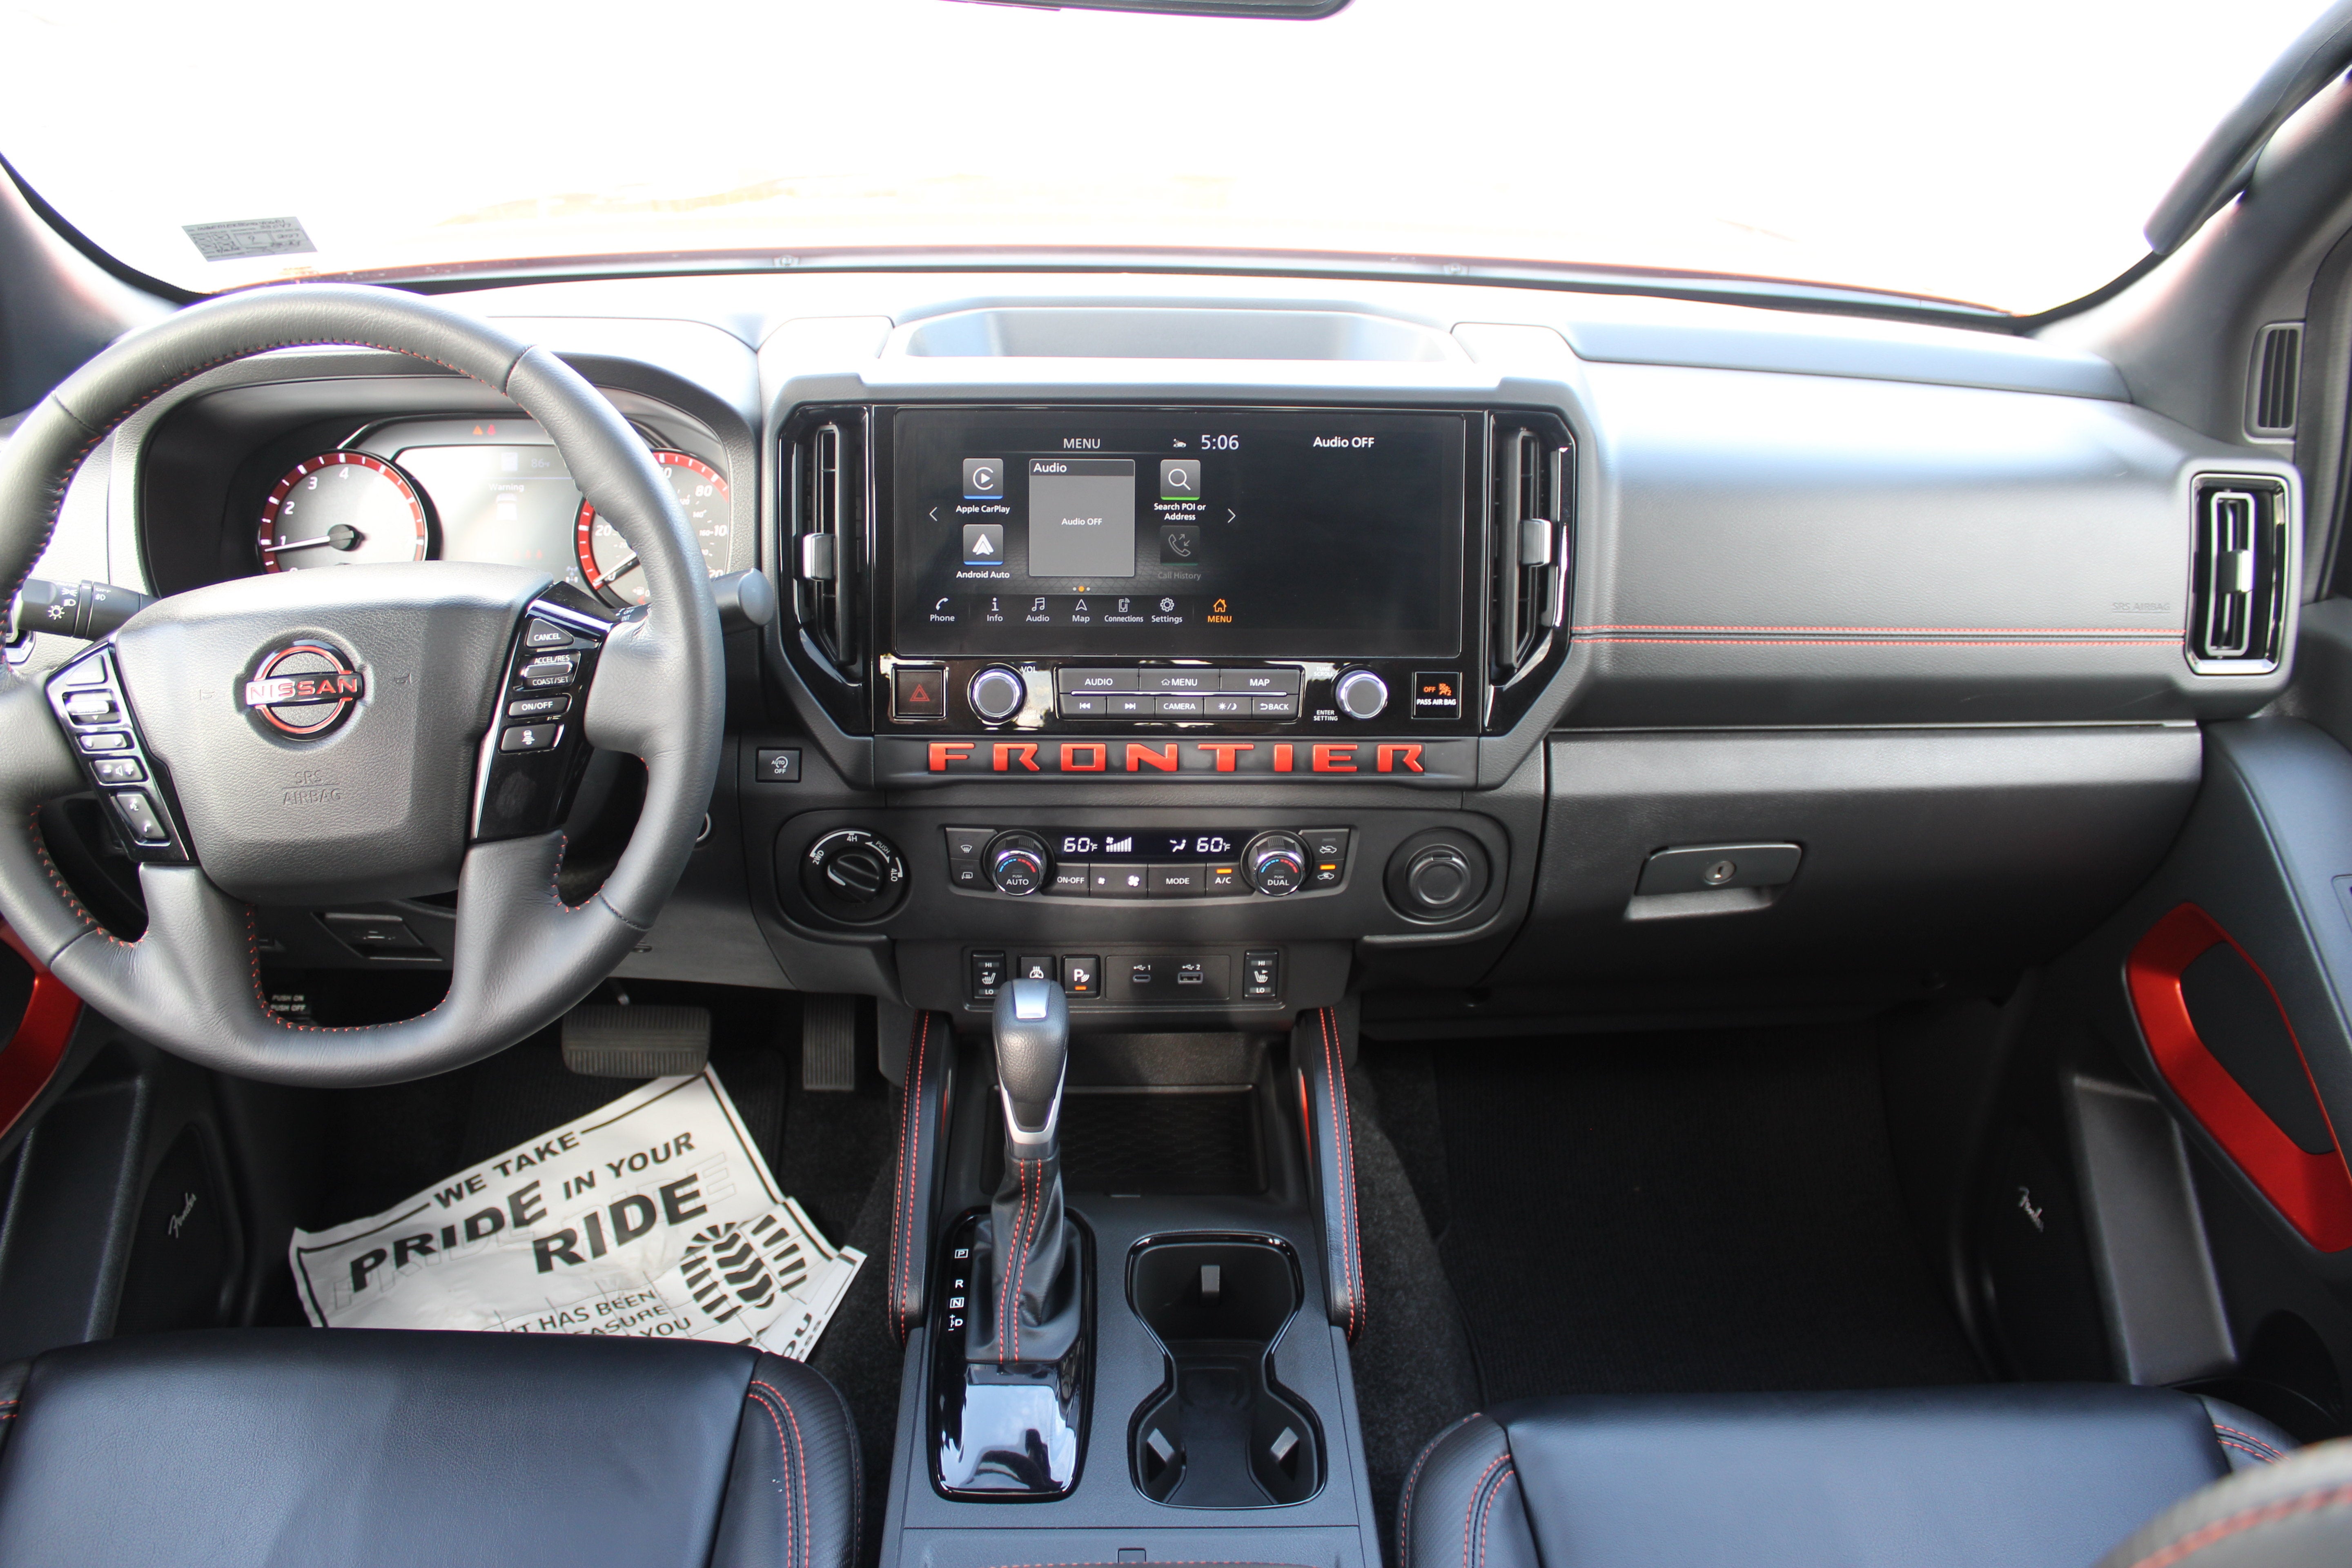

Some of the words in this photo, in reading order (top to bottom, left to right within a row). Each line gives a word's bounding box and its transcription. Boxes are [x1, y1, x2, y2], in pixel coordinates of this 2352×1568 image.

[1063, 439, 1101, 449] MENU
[1201, 435, 1239, 450] 5:06
[1313, 437, 1349, 448] Audio
[1352, 437, 1375, 448] OFF
[339, 467, 350, 479] 4
[1033, 463, 1067, 472] Audio
[308, 477, 318, 490] 3
[488, 483, 525, 492] Warning
[695, 485, 713, 497] 80
[285, 501, 295, 514] 2
[956, 505, 980, 514] Apple
[981, 505, 1010, 514] CarPlay
[1154, 503, 1180, 511] Search
[1182, 503, 1195, 511] POI
[1164, 512, 1196, 521] Address
[595, 525, 612, 536] 20
[956, 570, 989, 579] Android
[1174, 572, 1201, 581] History
[2112, 602, 2130, 611] SRS
[2133, 603, 2171, 611] AIRBAG
[1072, 615, 1090, 624] Map
[1152, 615, 1183, 624] Settings
[534, 633, 561, 641] CANCEL
[534, 654, 570, 664] ACCEL/RES
[532, 676, 569, 686] COAST/SET
[1171, 678, 1198, 686] MENU
[251, 678, 357, 700] NISSAN
[521, 701, 554, 711] ON/OFF
[929, 742, 1424, 772] FRONTIER
[295, 770, 323, 784] SRS
[283, 788, 342, 806] AIRBAG
[875, 841, 890, 854] PUSH
[813, 849, 824, 865] 2WD
[1074, 969, 1084, 982] P
[433, 1173, 487, 1209] WE
[492, 1131, 580, 1177] TAKE
[350, 1180, 548, 1293] PRIDE
[563, 1170, 596, 1200] IN
[606, 1131, 695, 1179] YOUR
[532, 1173, 708, 1274] RIDE
[955, 1279, 964, 1288] R
[539, 1307, 590, 1331] HAS
[595, 1289, 657, 1316] BEEN
[639, 1316, 692, 1338] YOU
[955, 1319, 964, 1327] D
